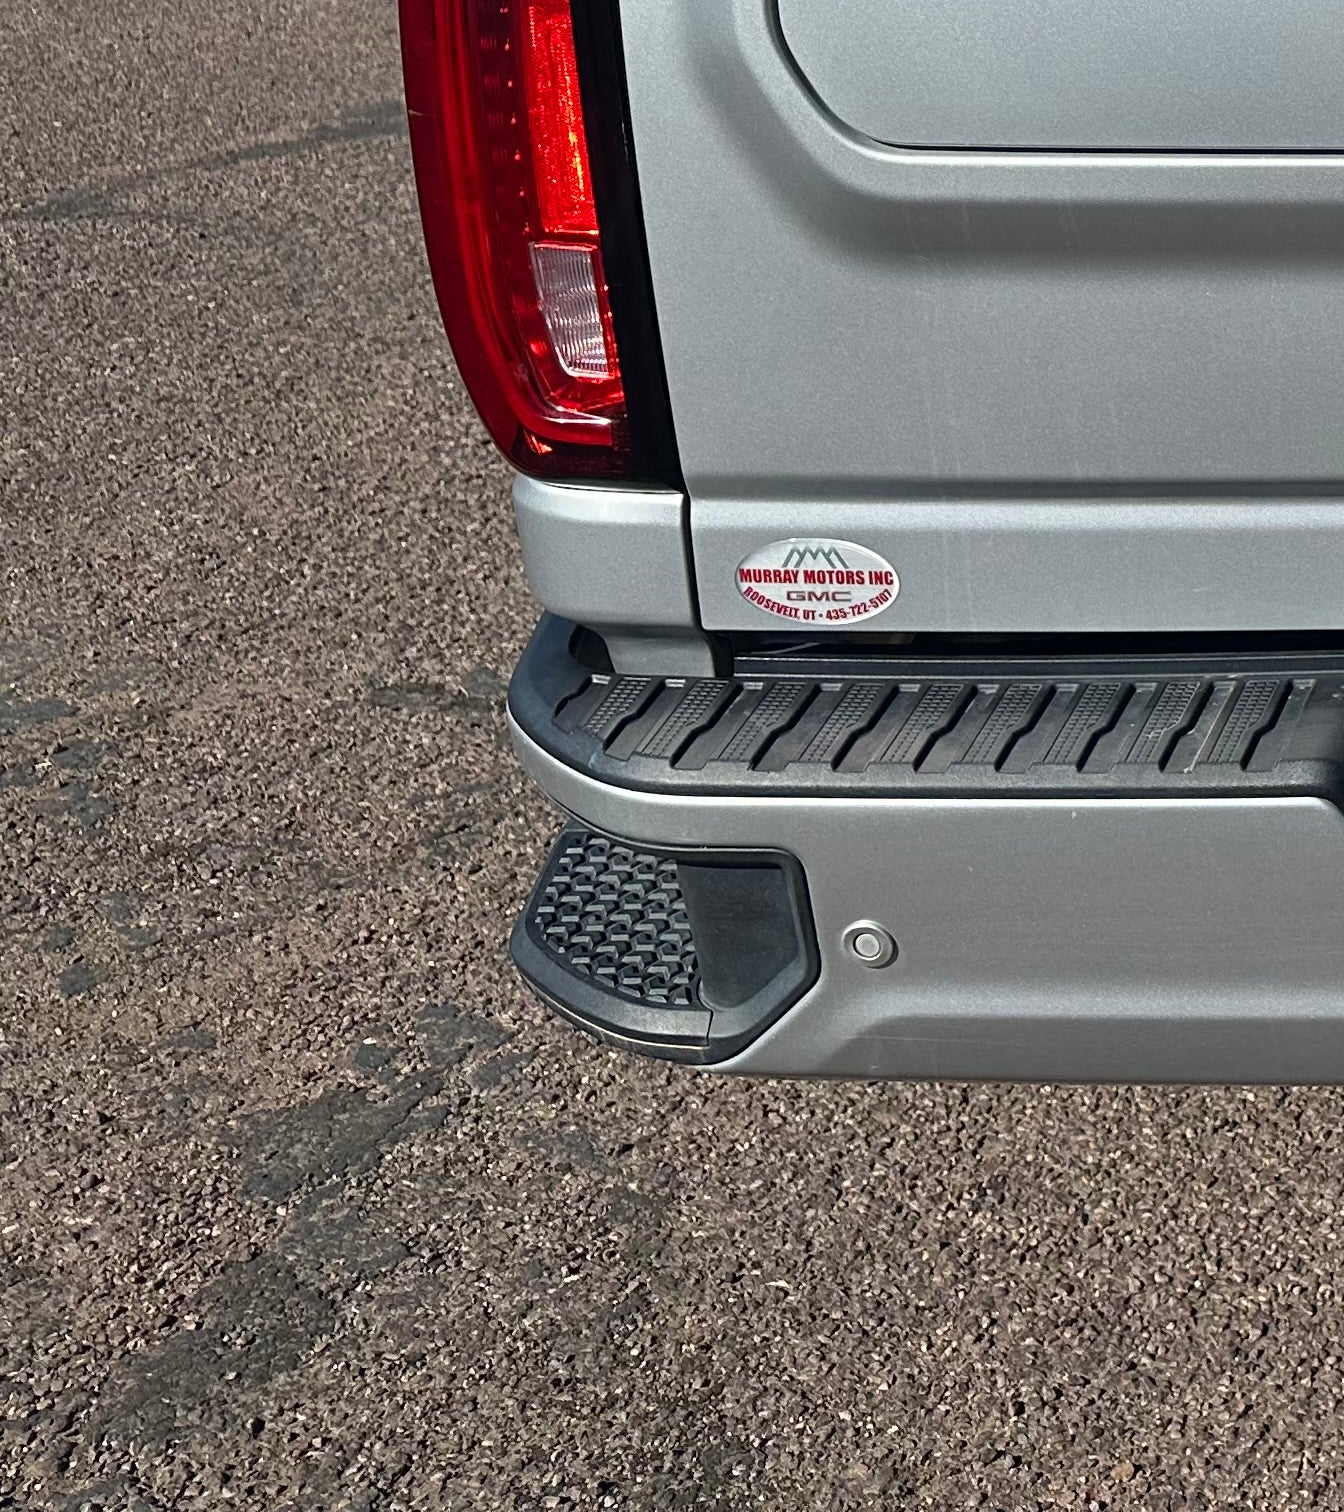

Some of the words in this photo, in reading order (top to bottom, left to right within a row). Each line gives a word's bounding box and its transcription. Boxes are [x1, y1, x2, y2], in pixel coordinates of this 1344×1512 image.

[738, 568, 799, 585] MURRAY
[803, 570, 865, 586] MOTORS
[868, 571, 894, 586] INC
[786, 590, 852, 602] GMC
[803, 609, 817, 621] UT
[825, 588, 894, 621] 435-722-5107
